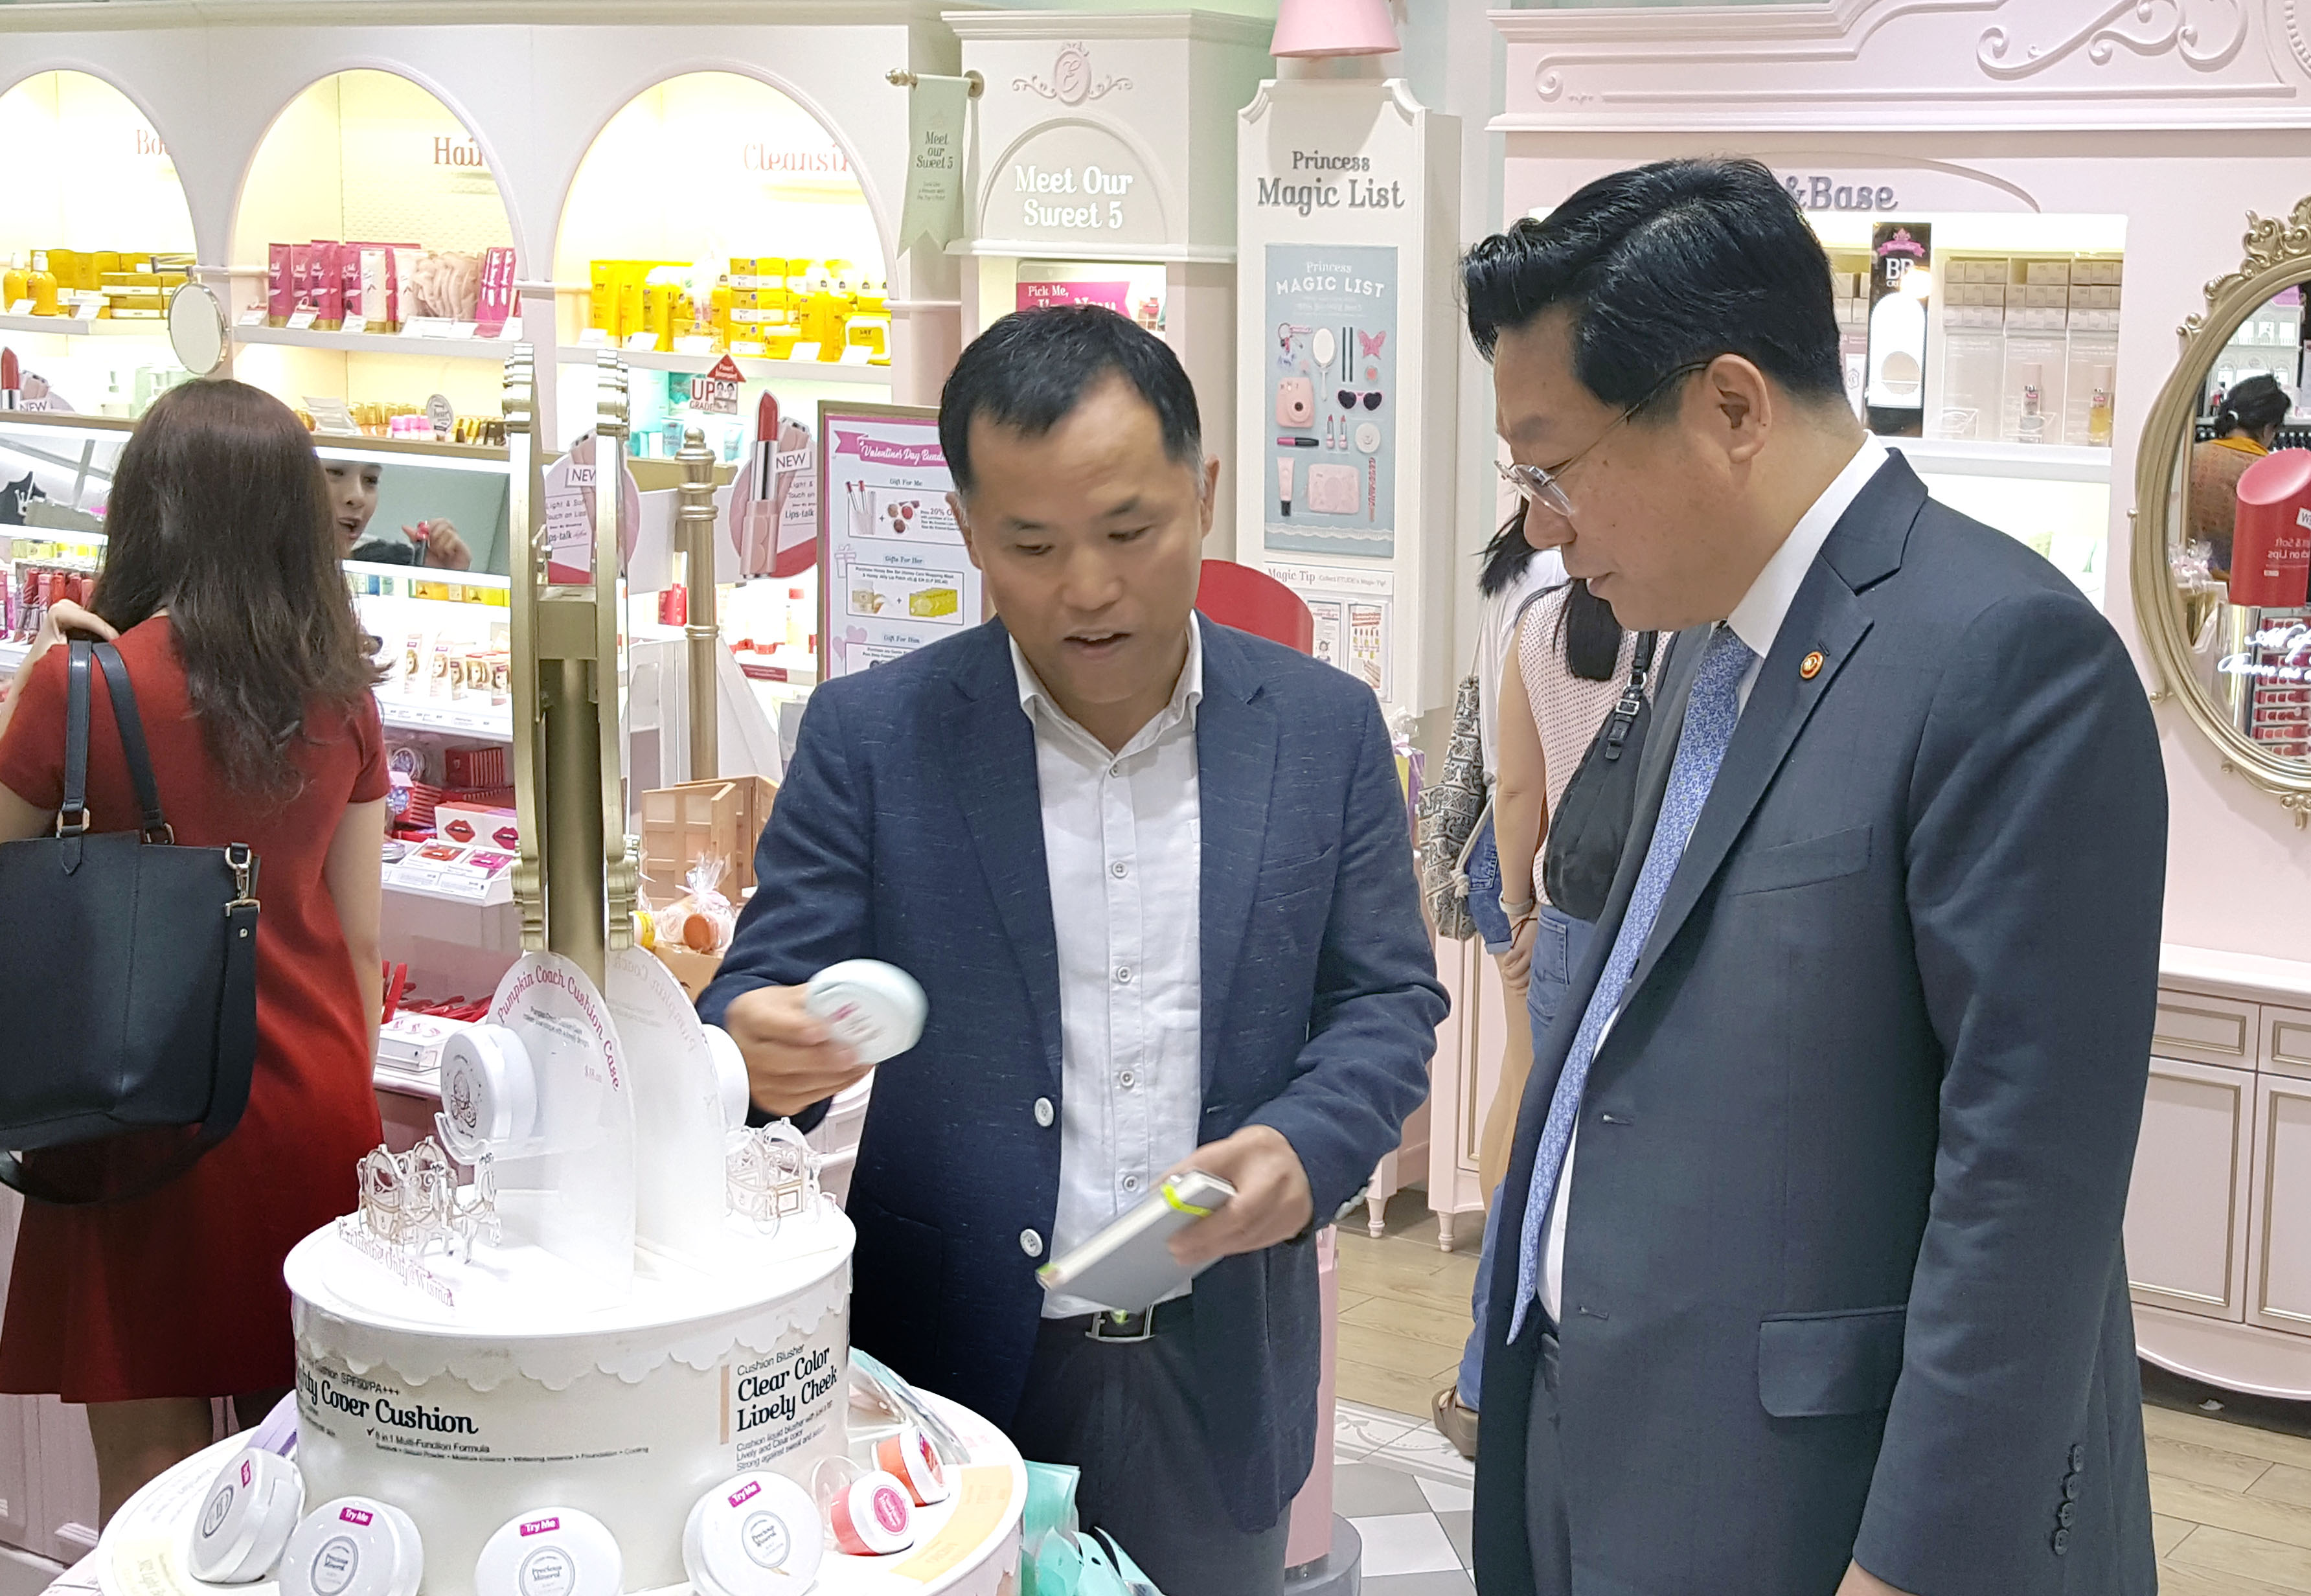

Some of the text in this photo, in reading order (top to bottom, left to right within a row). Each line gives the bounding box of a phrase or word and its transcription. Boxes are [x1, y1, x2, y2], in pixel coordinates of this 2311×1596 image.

[925, 131, 948, 145] Meet
[928, 147, 945, 157] our
[916, 155, 953, 169] Sweet 5
[1292, 150, 1371, 172] Princess
[1014, 165, 1133, 195] Meet Our
[1257, 176, 1406, 217] Magic List
[1023, 198, 1124, 229] Sweet 5
[1306, 260, 1352, 273] Princess
[1028, 284, 1070, 297] Pick Me,
[1275, 275, 1385, 298] MAGIC LIST
[691, 378, 715, 402] UP
[689, 400, 715, 412] GRADE
[776, 453, 806, 469] NEW
[903, 447, 920, 466] Day
[889, 477, 923, 488] Gift For Me
[885, 555, 899, 564] Gifts
[1299, 570, 1315, 585] Tip
[883, 633, 894, 643] Gift
[497, 971, 534, 1025] Pumpkin
[535, 964, 566, 990] Coach
[567, 975, 604, 1040] Cushion
[603, 1040, 620, 1092] Case
[737, 1343, 805, 1376] Cushion Blusher
[738, 1347, 830, 1402] Clear Color
[736, 1365, 838, 1433] Lively Cheek
[321, 1380, 370, 1418] Cover
[375, 1398, 479, 1435] Cushion
[453, 1442, 490, 1454] Formula
[731, 1483, 758, 1503] Try Me
[343, 1507, 369, 1522] Try Me
[524, 1519, 557, 1534] Try Me
